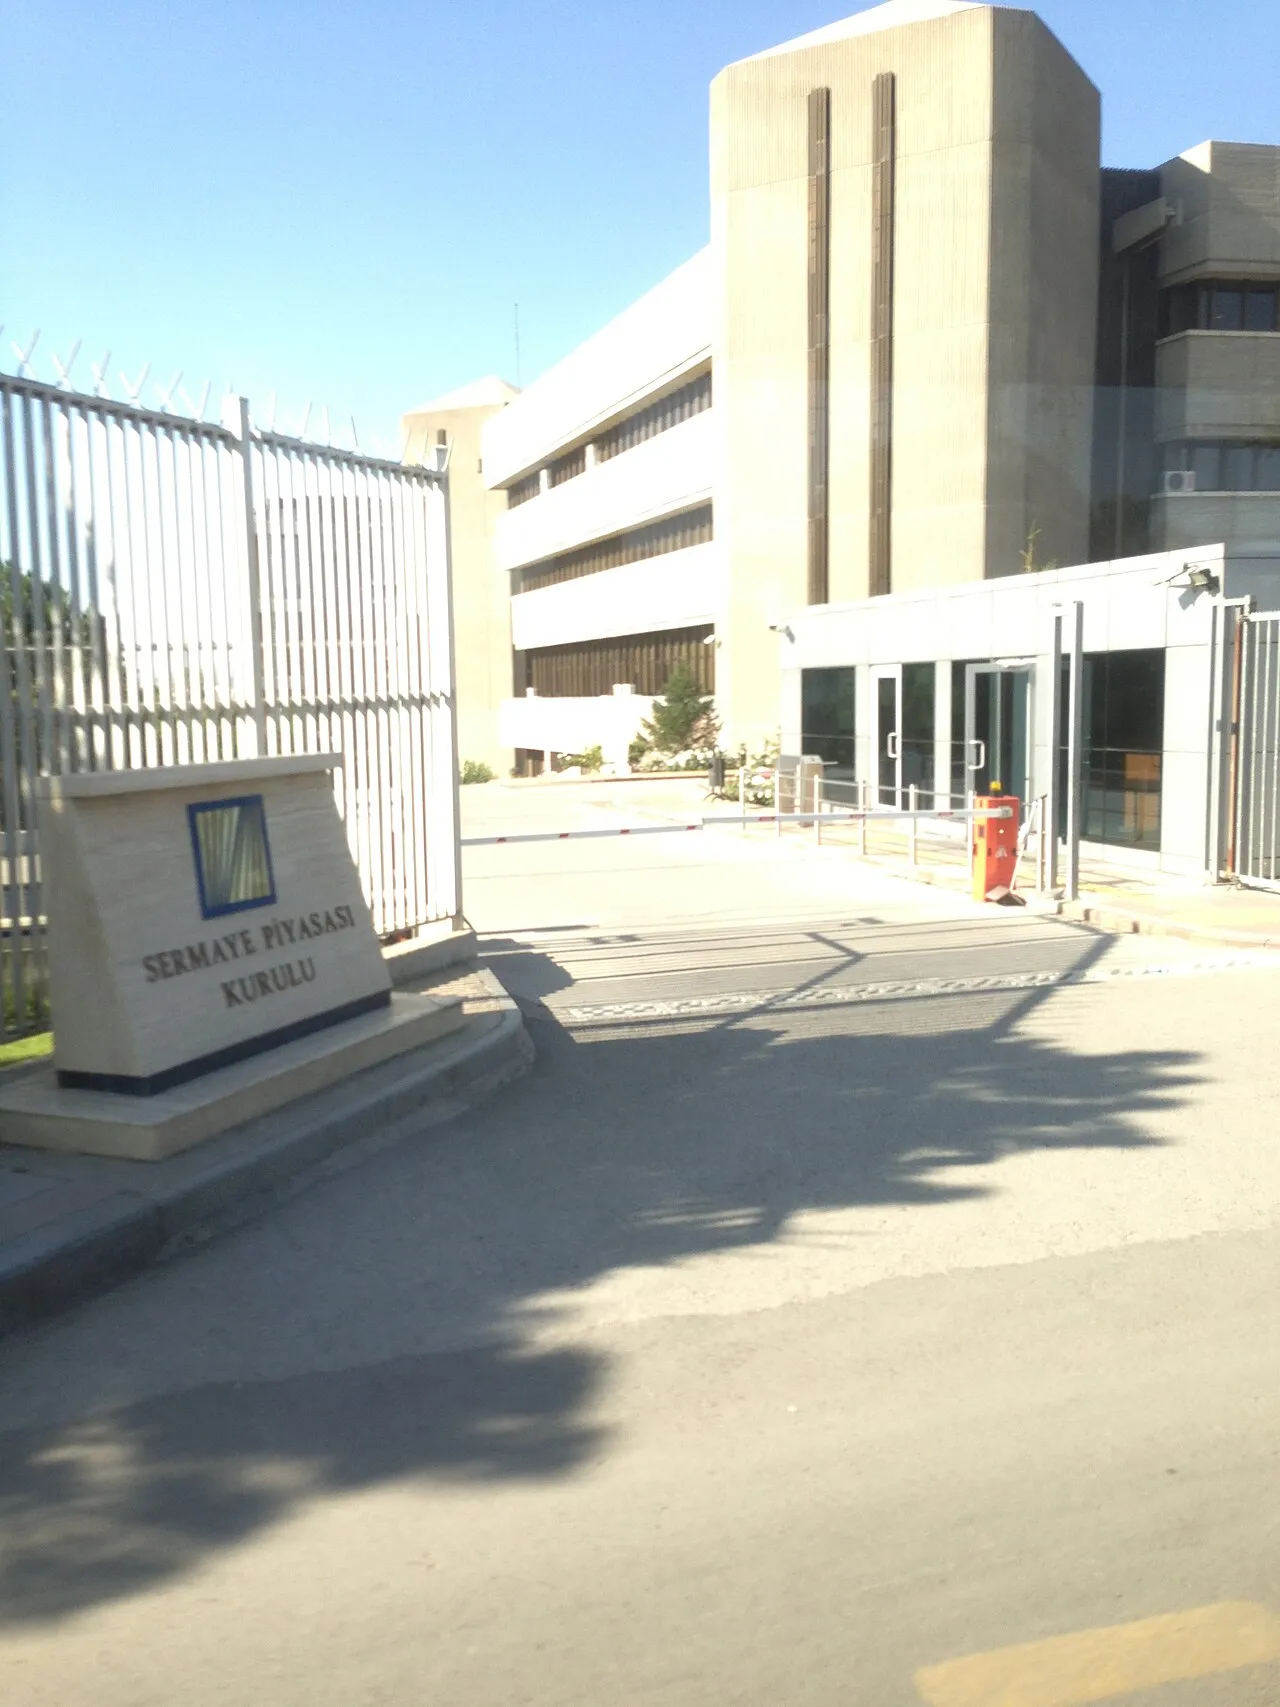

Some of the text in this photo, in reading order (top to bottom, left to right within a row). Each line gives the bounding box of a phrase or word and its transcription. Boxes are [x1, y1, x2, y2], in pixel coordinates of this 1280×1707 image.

[143, 905, 356, 983] SERMAYE PİYASASI
[221, 957, 317, 1007] KURULU
